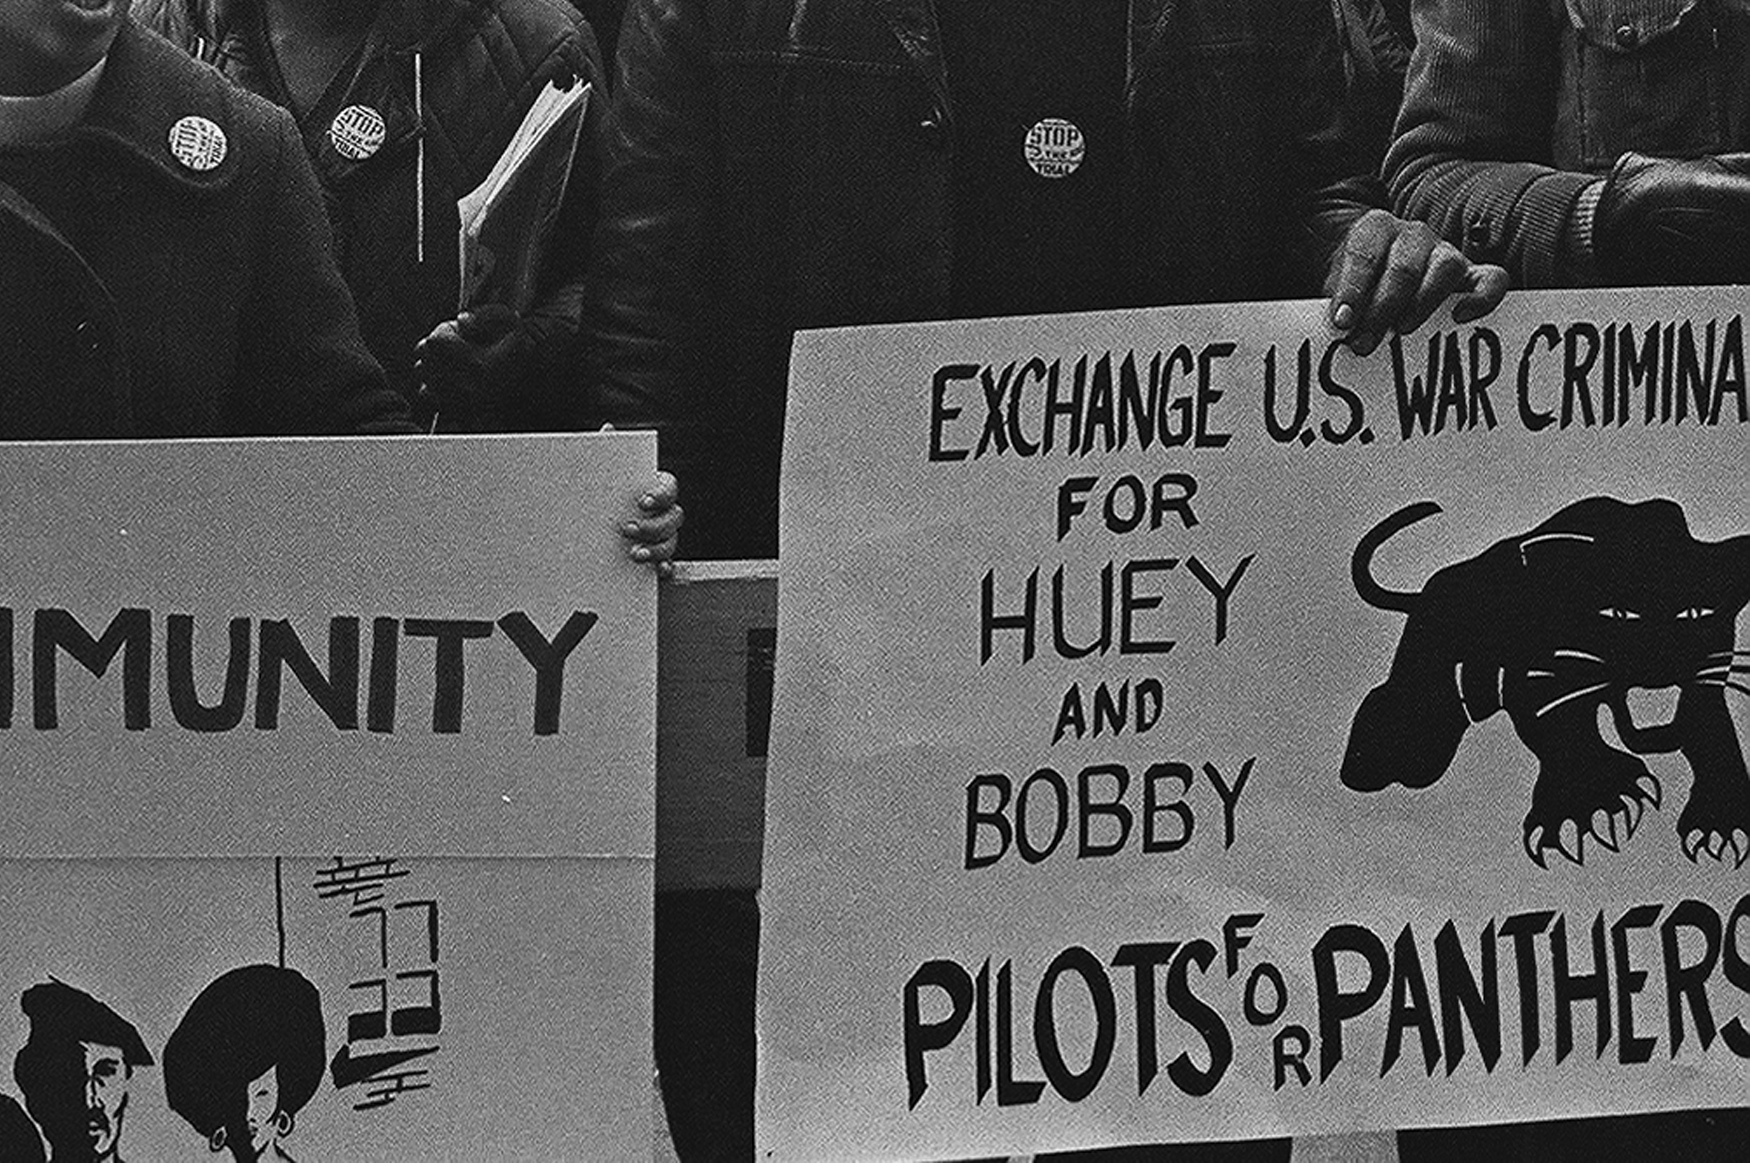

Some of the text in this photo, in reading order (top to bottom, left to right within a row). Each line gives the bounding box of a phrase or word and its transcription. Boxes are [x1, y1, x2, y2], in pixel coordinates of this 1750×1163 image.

[339, 108, 384, 137] STOP
[1029, 125, 1080, 148] STOP
[928, 313, 1750, 462] EXCHANGE U.S. WAR CRIMINA
[1057, 473, 1199, 541] FOR
[980, 554, 1256, 666] HUEY
[1051, 677, 1164, 745] AND
[964, 757, 1256, 871] BOBBY
[903, 938, 1233, 1110] PILOTS
[1223, 912, 1312, 1091] FOR
